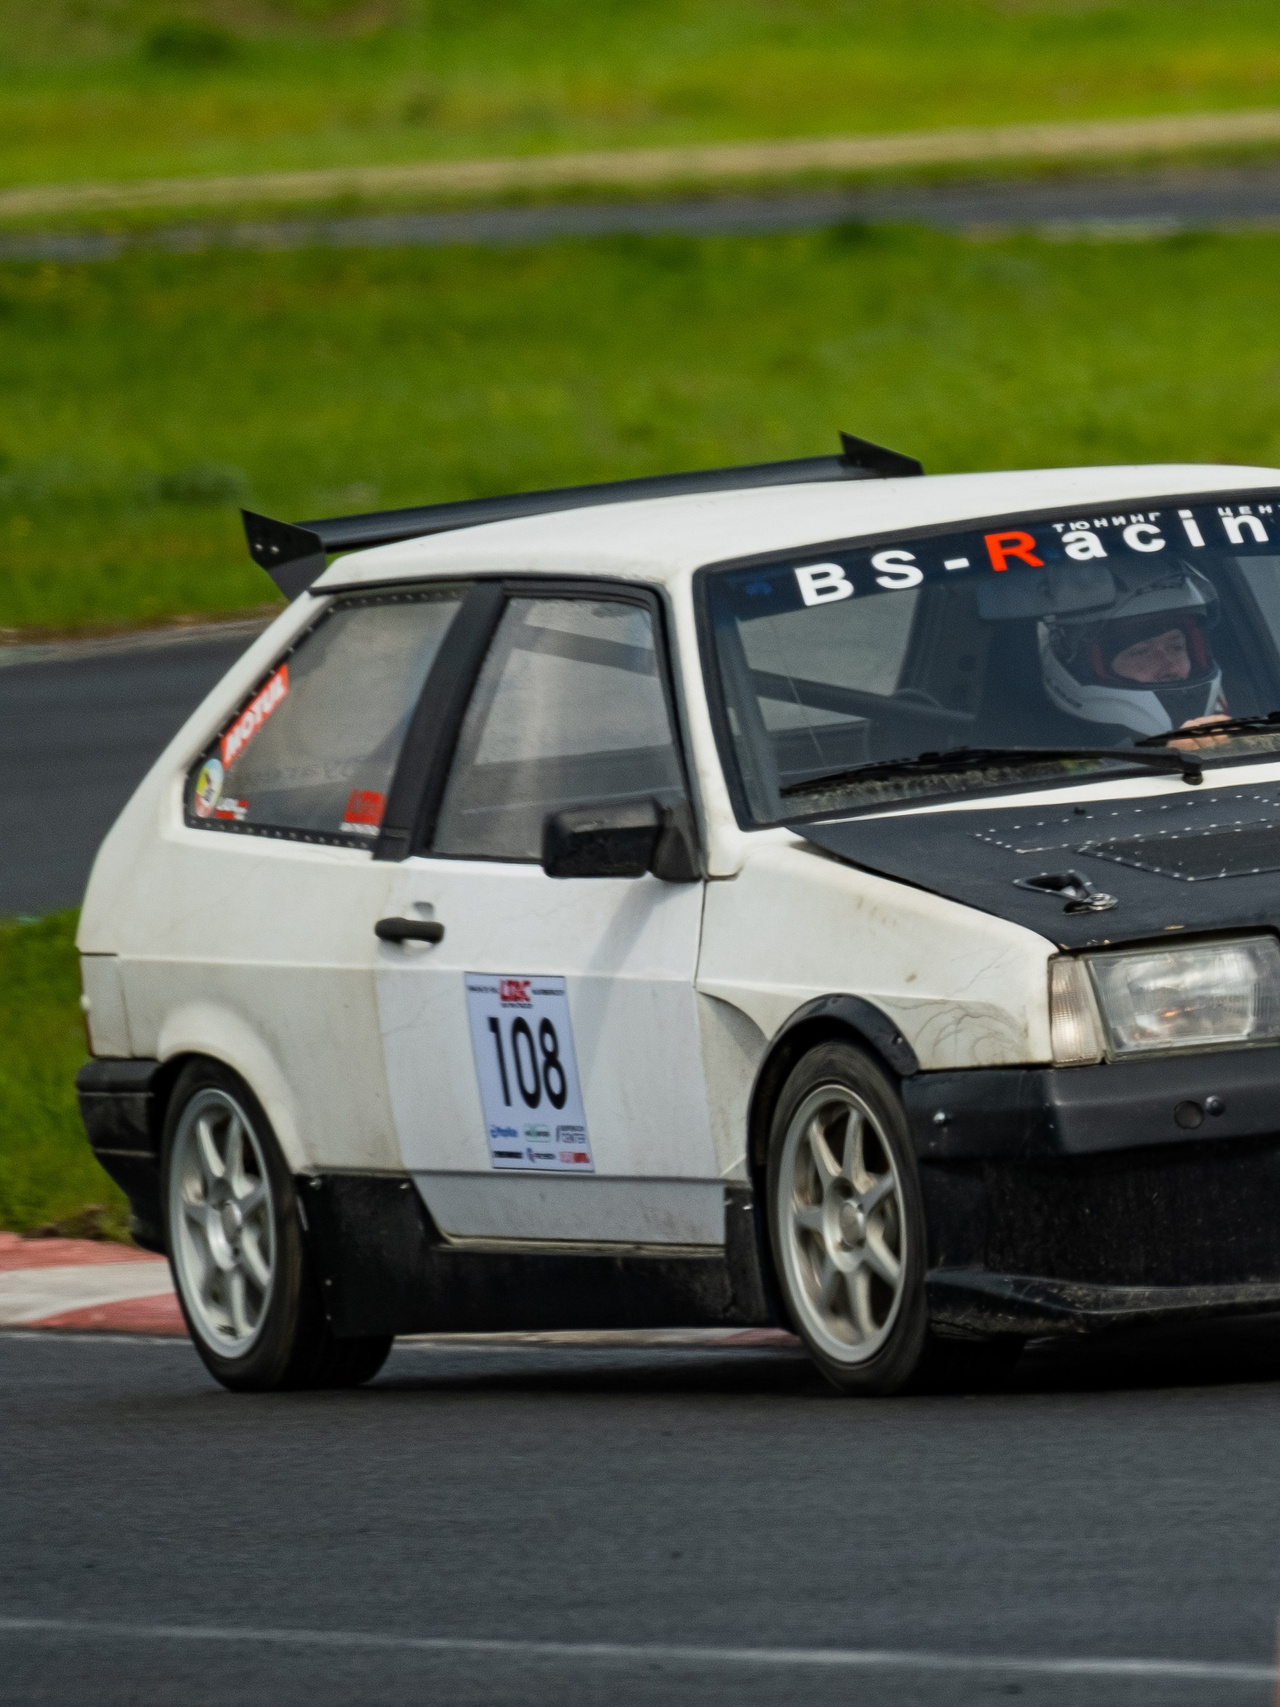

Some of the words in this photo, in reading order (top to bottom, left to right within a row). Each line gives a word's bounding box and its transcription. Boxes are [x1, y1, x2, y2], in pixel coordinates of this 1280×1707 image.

[1051, 512, 1162, 533] ТЮНИНГ
[223, 672, 286, 765] MOTUL
[487, 1016, 568, 1110] 108
